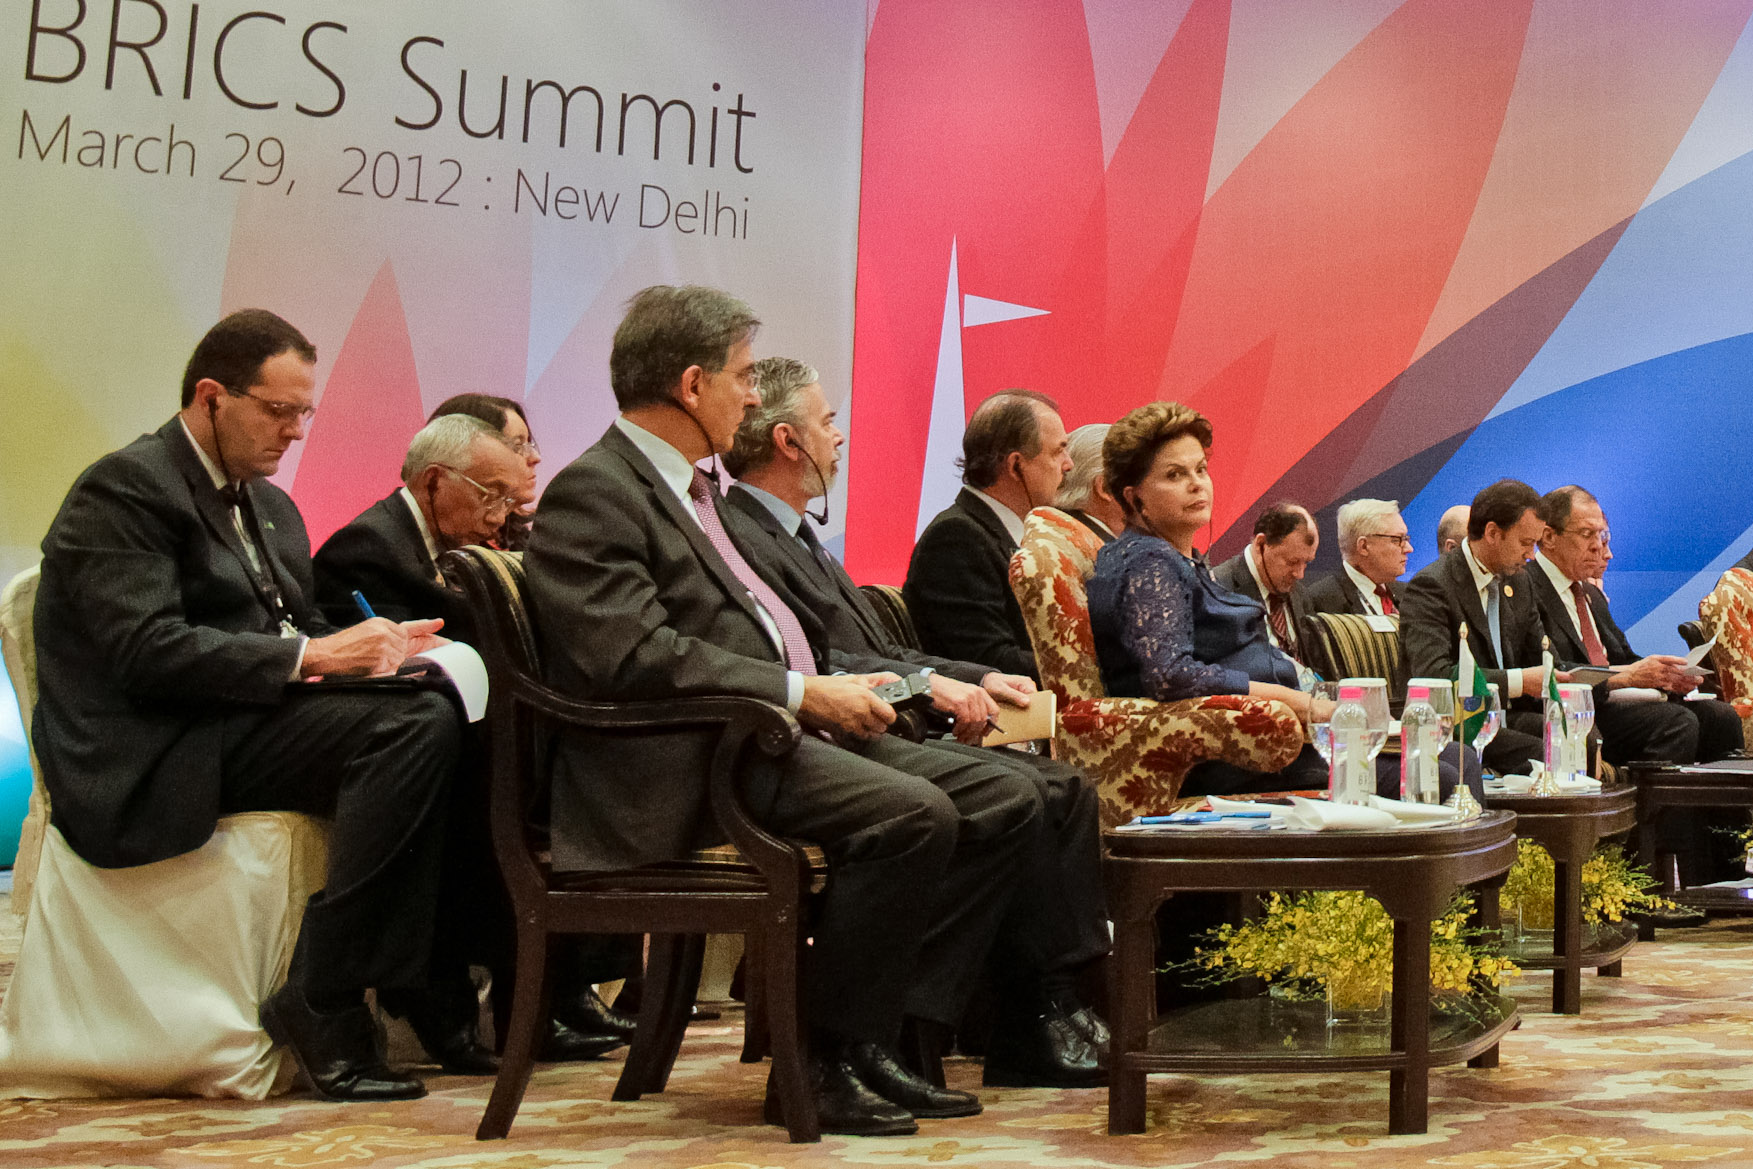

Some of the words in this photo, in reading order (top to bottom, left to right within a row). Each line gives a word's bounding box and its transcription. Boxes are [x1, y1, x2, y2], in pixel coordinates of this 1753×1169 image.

[393, 35, 757, 174] Summit
[17, 109, 196, 178] March
[218, 132, 296, 197] 29,
[336, 146, 463, 208] 2012
[513, 168, 621, 225] New
[638, 184, 749, 241] Delhi
